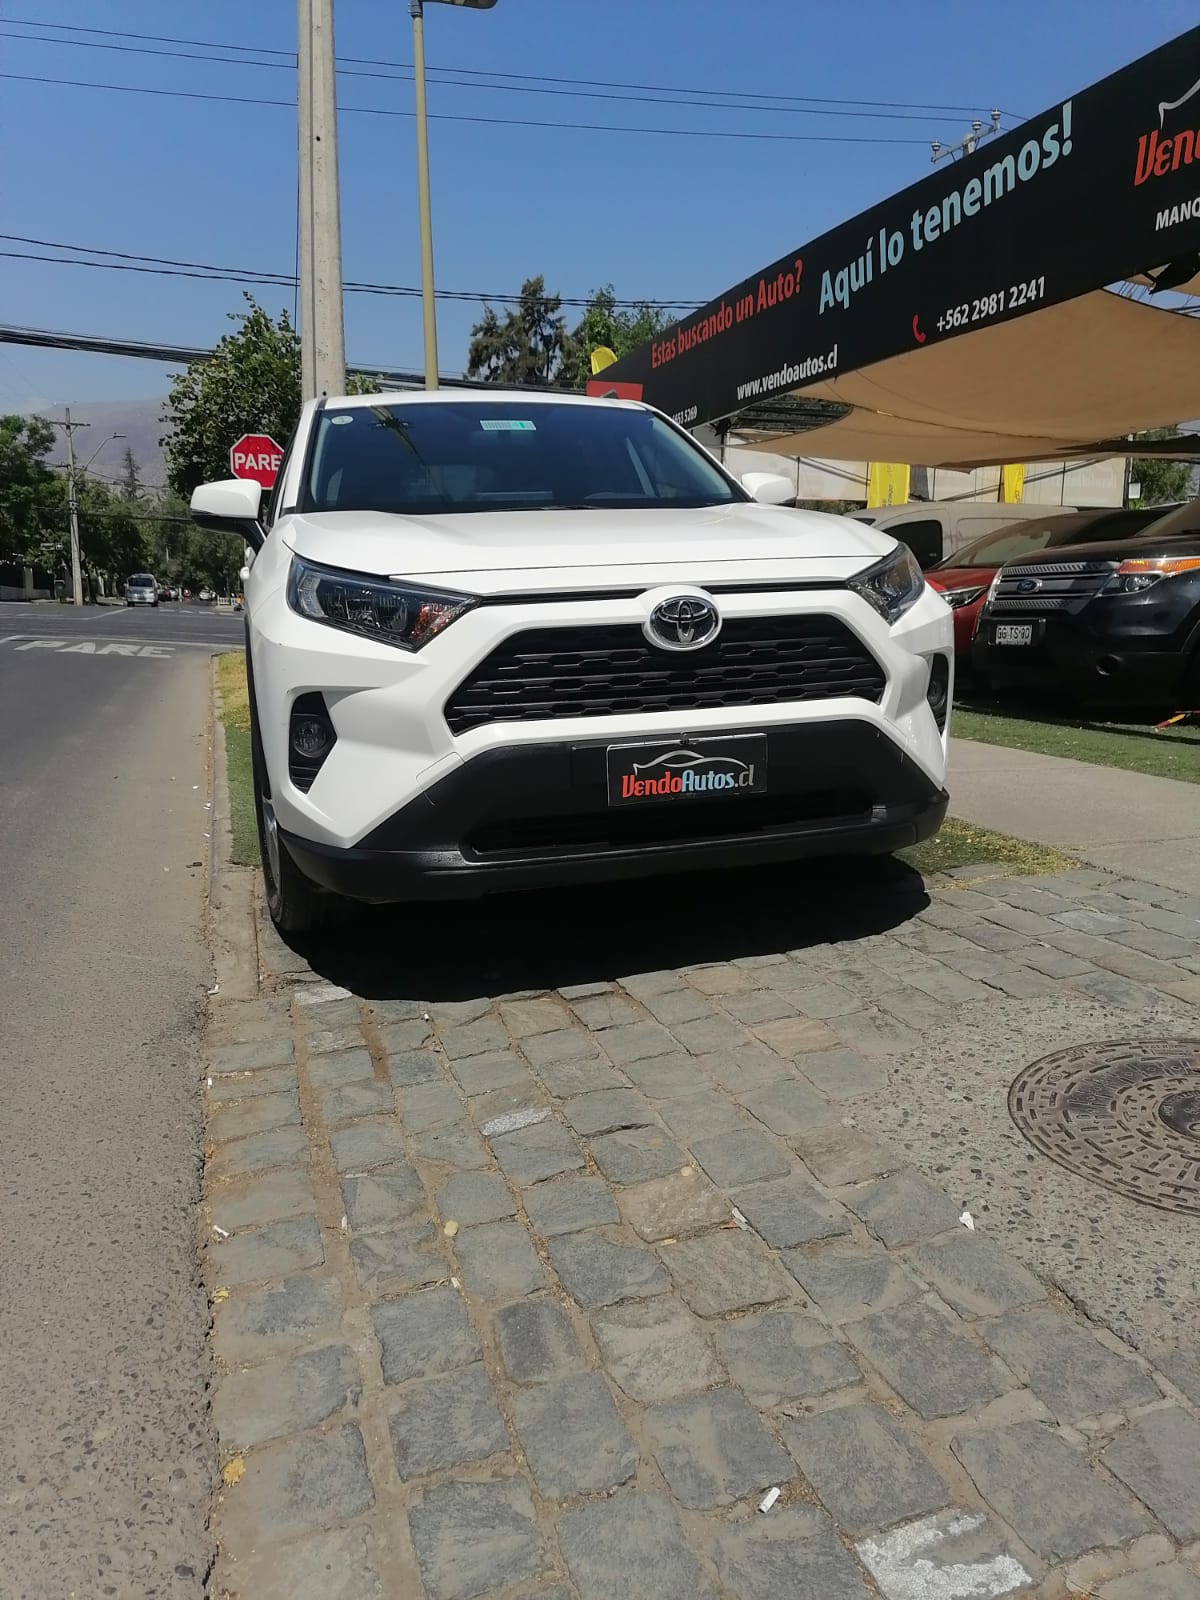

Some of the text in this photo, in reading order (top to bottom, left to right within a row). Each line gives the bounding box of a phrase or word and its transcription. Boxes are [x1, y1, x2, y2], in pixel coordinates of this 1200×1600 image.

[818, 99, 1073, 315] Aquí lo tenemos!
[651, 259, 803, 369] Estas buscando un Auto?
[936, 276, 1045, 332] +562 2981 2241
[737, 343, 838, 400] www.vendoautos.cl
[234, 452, 282, 471] PARE
[13, 640, 176, 659] PARE
[622, 764, 754, 798] VendoAutos.cl
